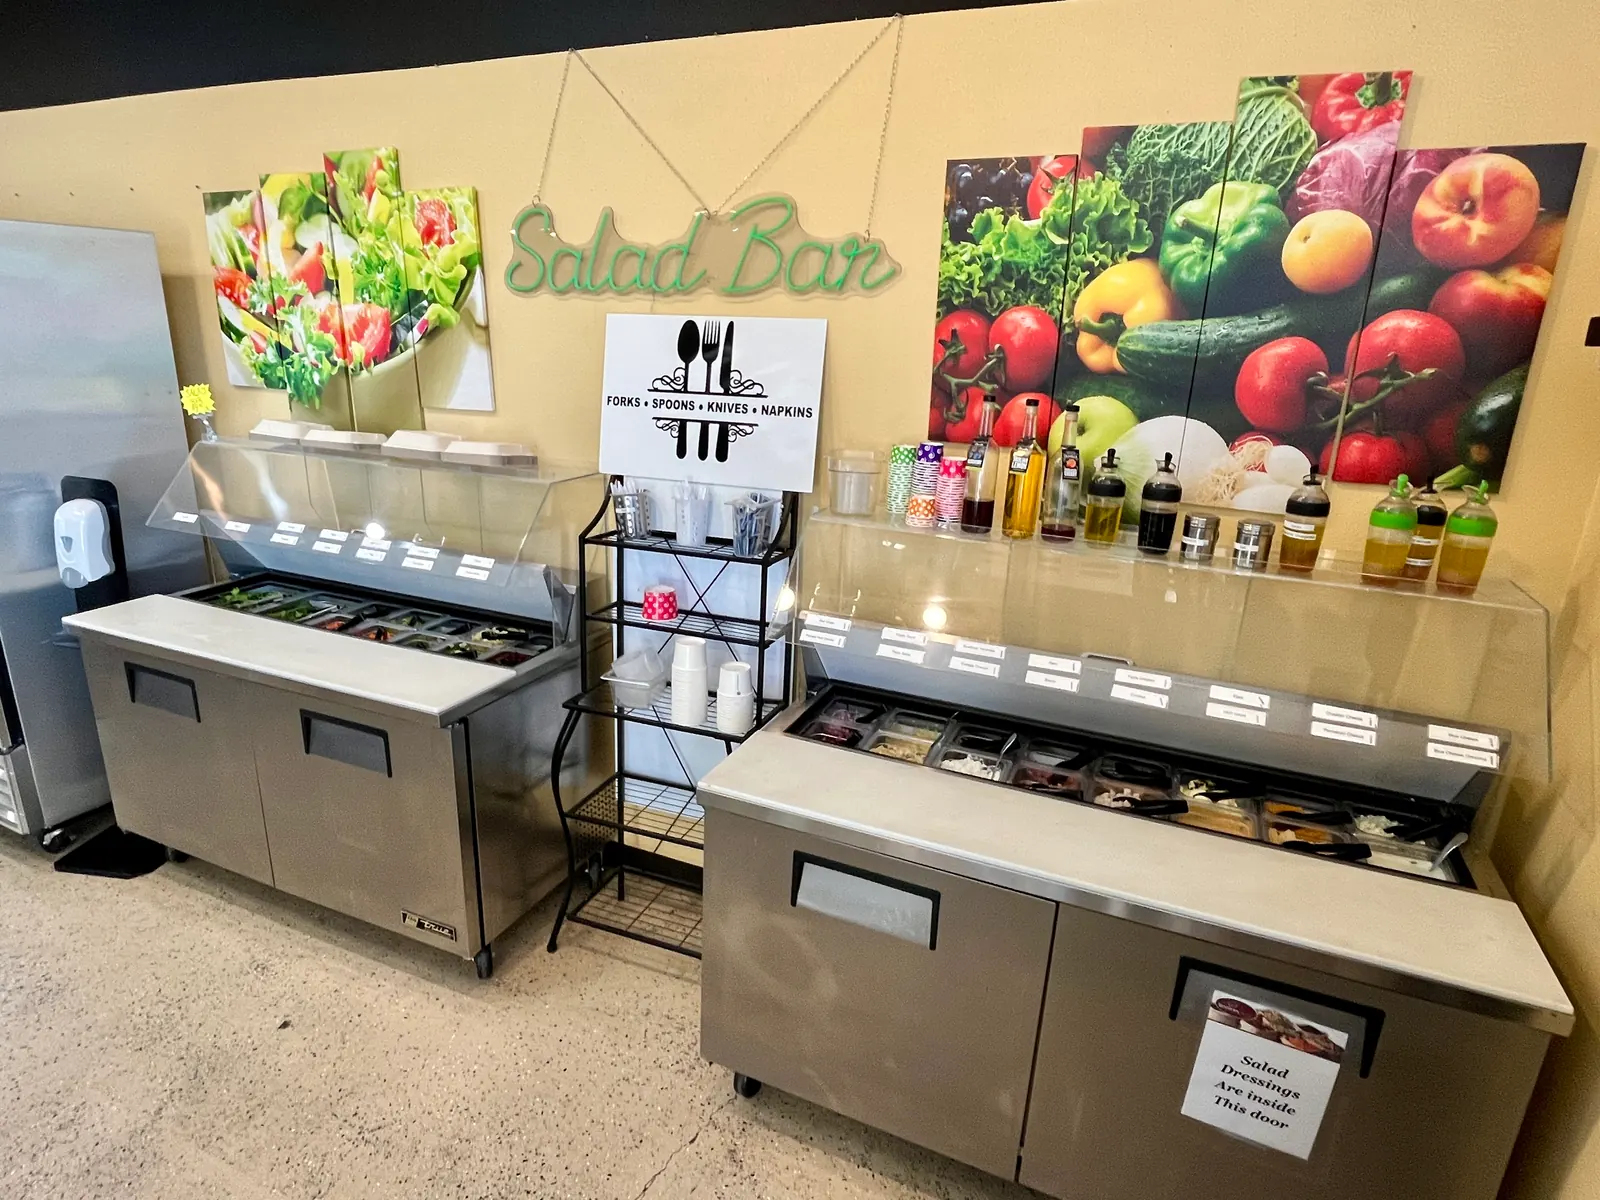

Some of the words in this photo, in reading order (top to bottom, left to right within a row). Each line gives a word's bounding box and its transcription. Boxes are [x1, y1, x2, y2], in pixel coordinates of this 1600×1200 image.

[507, 207, 707, 294] Salad
[722, 196, 897, 294] Bar
[606, 395, 641, 408] FORKS
[652, 398, 696, 411] SPOONS
[707, 401, 749, 415] KNIVES
[761, 404, 813, 419] NAPKINS
[1221, 1064, 1301, 1100] Dressings
[1240, 1055, 1290, 1079] Salad
[1213, 1095, 1247, 1114] This
[1250, 1110, 1289, 1130] door
[1214, 1080, 1243, 1096] Are
[1247, 1090, 1296, 1116] inside
